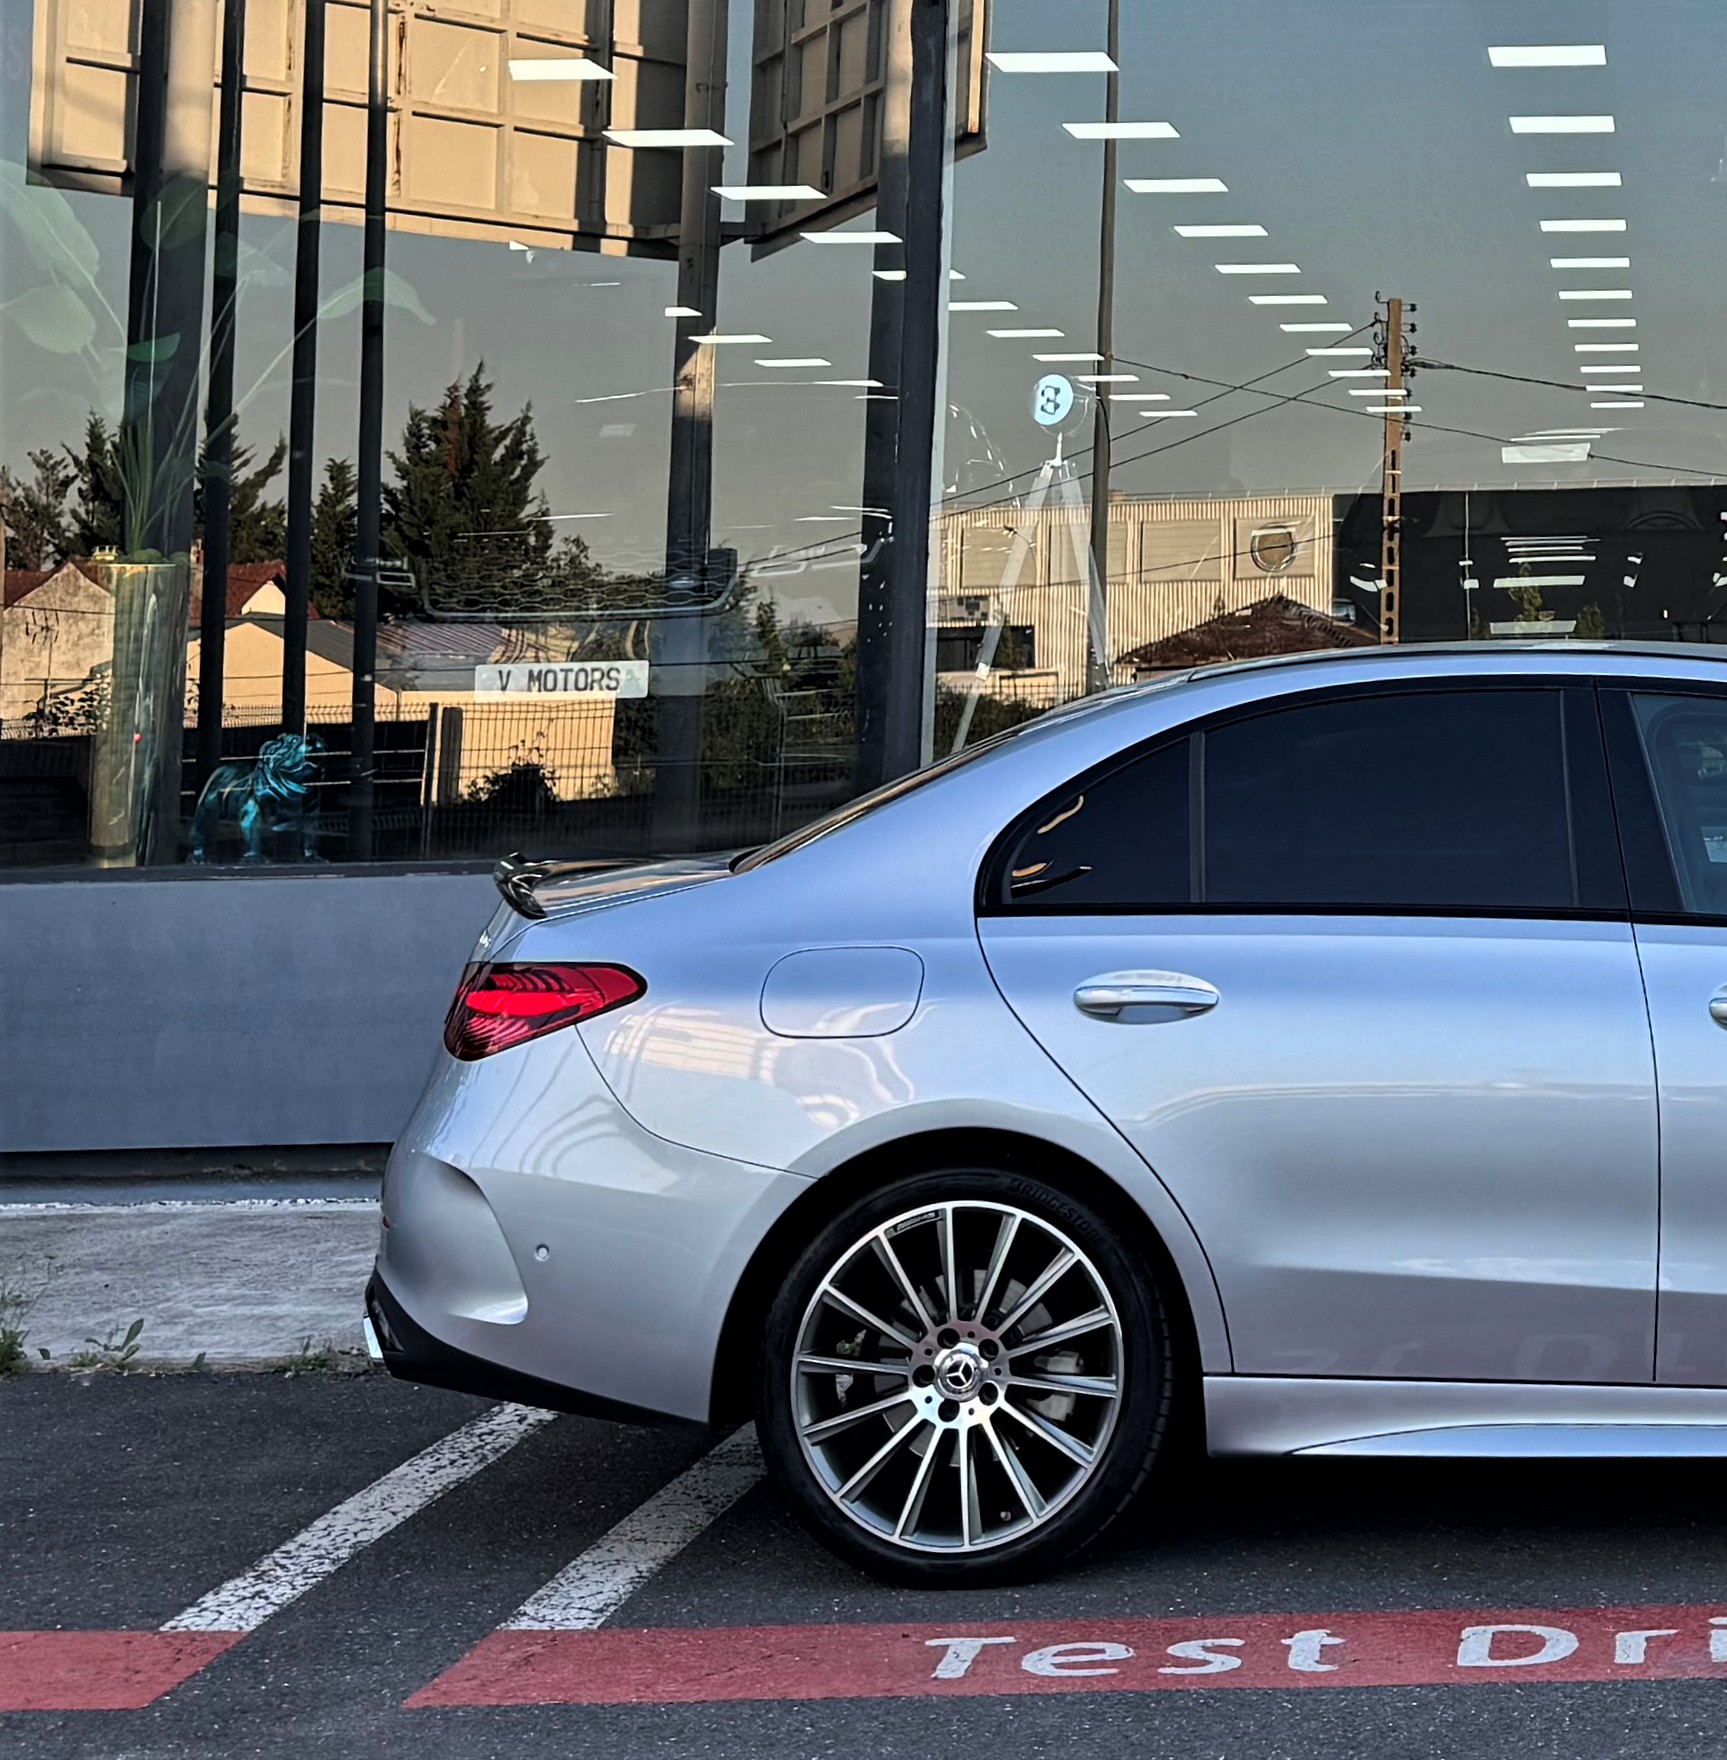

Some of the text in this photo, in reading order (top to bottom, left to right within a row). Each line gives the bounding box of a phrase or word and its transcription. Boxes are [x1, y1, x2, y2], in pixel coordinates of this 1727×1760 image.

[498, 667, 621, 693] V MOTORS
[925, 1629, 1346, 1679] Test
